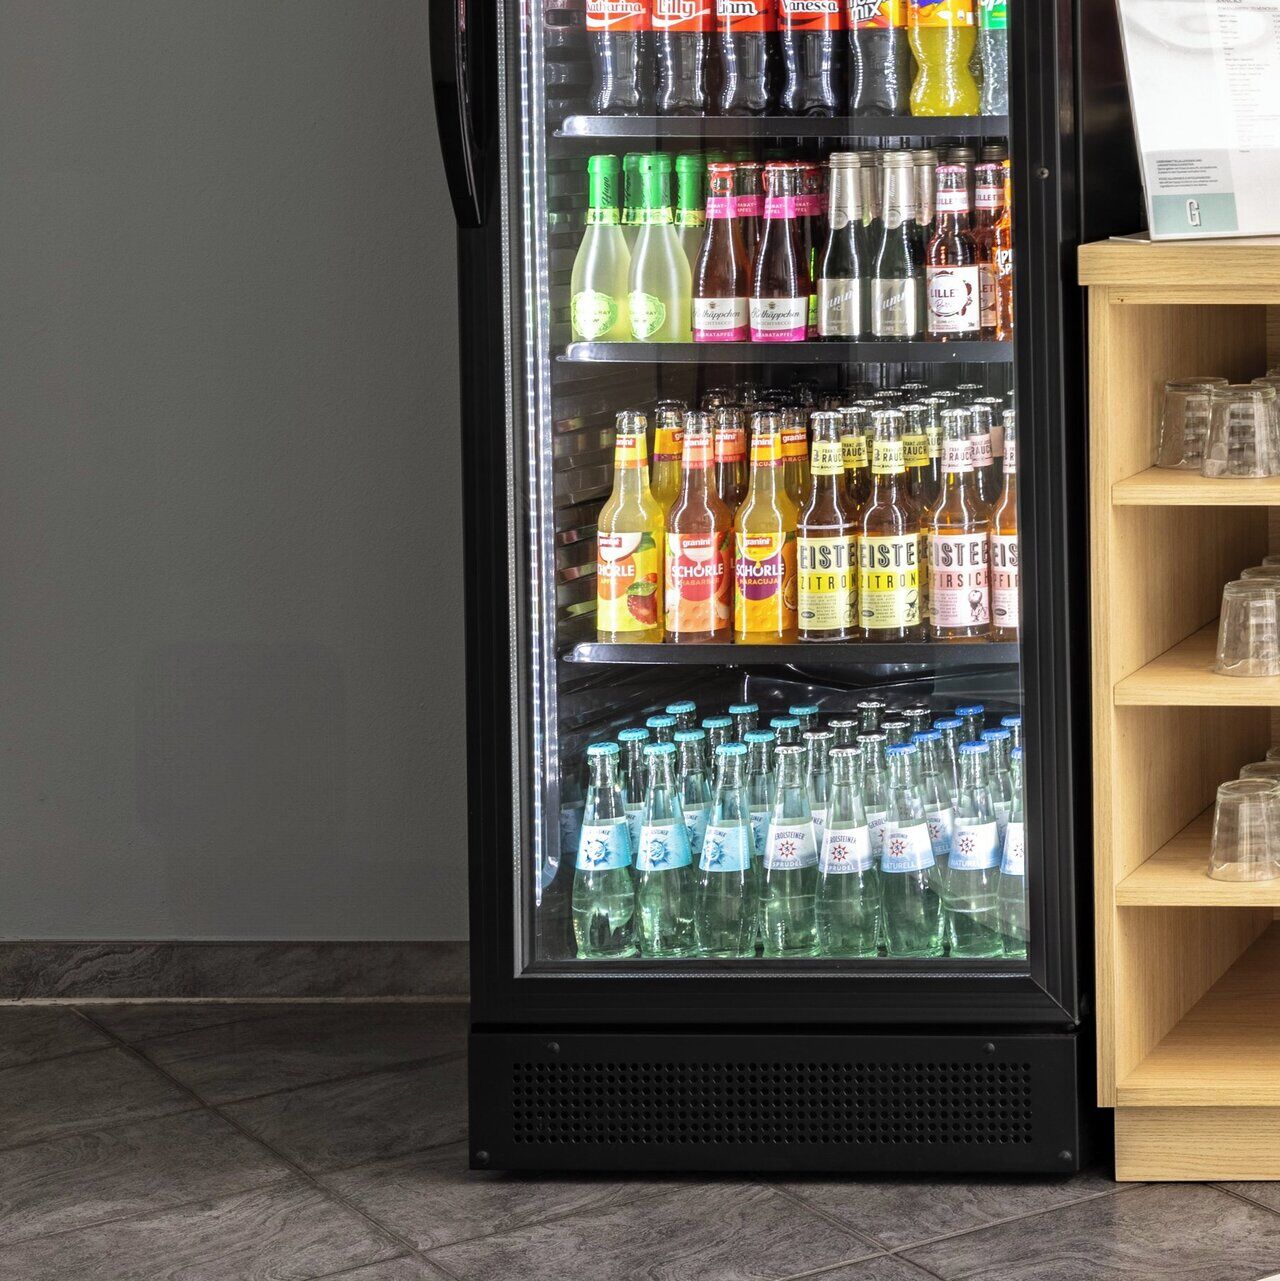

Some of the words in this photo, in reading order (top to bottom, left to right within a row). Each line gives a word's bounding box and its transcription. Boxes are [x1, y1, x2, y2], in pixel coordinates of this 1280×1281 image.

[930, 289, 955, 298] LILLE
[694, 309, 741, 321] tkäppchen
[782, 434, 806, 443] granini
[682, 538, 713, 548] granini
[598, 563, 635, 577] CHORLE
[671, 562, 723, 578] SCHORLE
[736, 563, 785, 577] SCHORLE
[800, 571, 856, 590] ZITRON
[859, 570, 917, 589] ZITRON
[931, 571, 988, 588] FIRSICH
